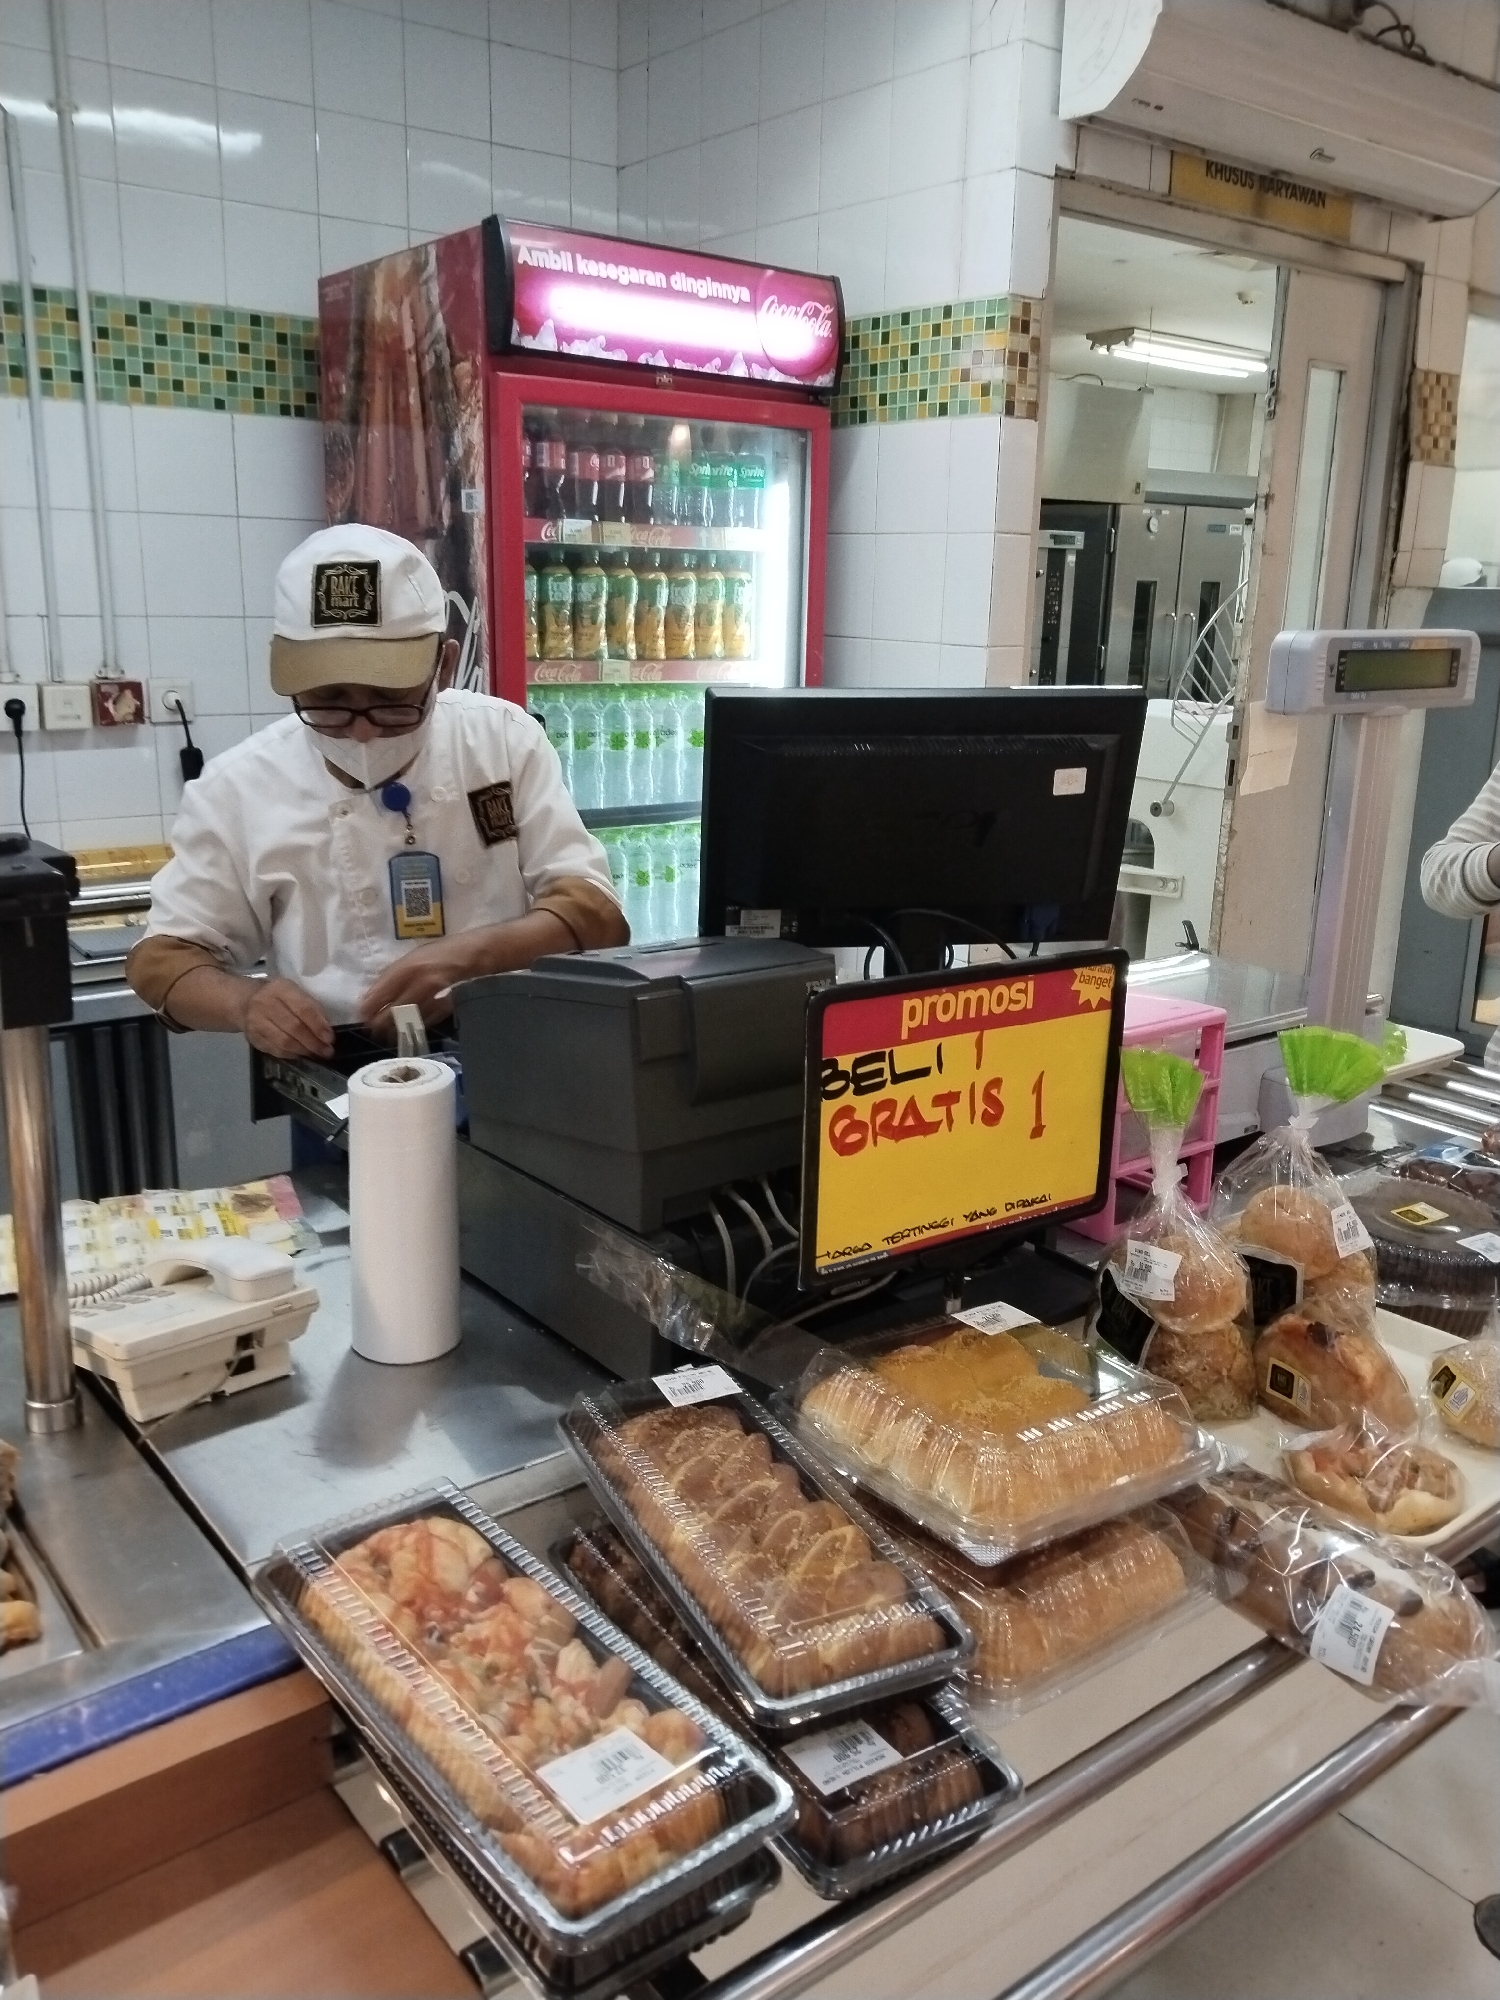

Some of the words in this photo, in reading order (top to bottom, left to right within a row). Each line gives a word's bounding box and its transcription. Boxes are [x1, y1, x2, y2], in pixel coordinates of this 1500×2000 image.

[1206, 160, 1254, 189] KHUSUS
[1258, 175, 1326, 208] KARYAWAN
[518, 245, 572, 271] Ambil
[577, 253, 666, 289] kesegaran
[671, 271, 750, 303] dinginnya
[760, 295, 834, 338] Coca-Cola
[331, 575, 359, 595] BAKE
[331, 596, 359, 607] mart
[534, 663, 582, 682] Coca-Cola
[1079, 970, 1112, 989] banget
[901, 976, 1034, 1039] promosi
[821, 1043, 943, 1102] BELI
[829, 1077, 1004, 1157] GRATIS
[1029, 1070, 1047, 1139] 1
[882, 1217, 954, 1246] TERTINGGI
[963, 1207, 997, 1223] YANG
[1005, 1194, 1052, 1212] DIPAKAI
